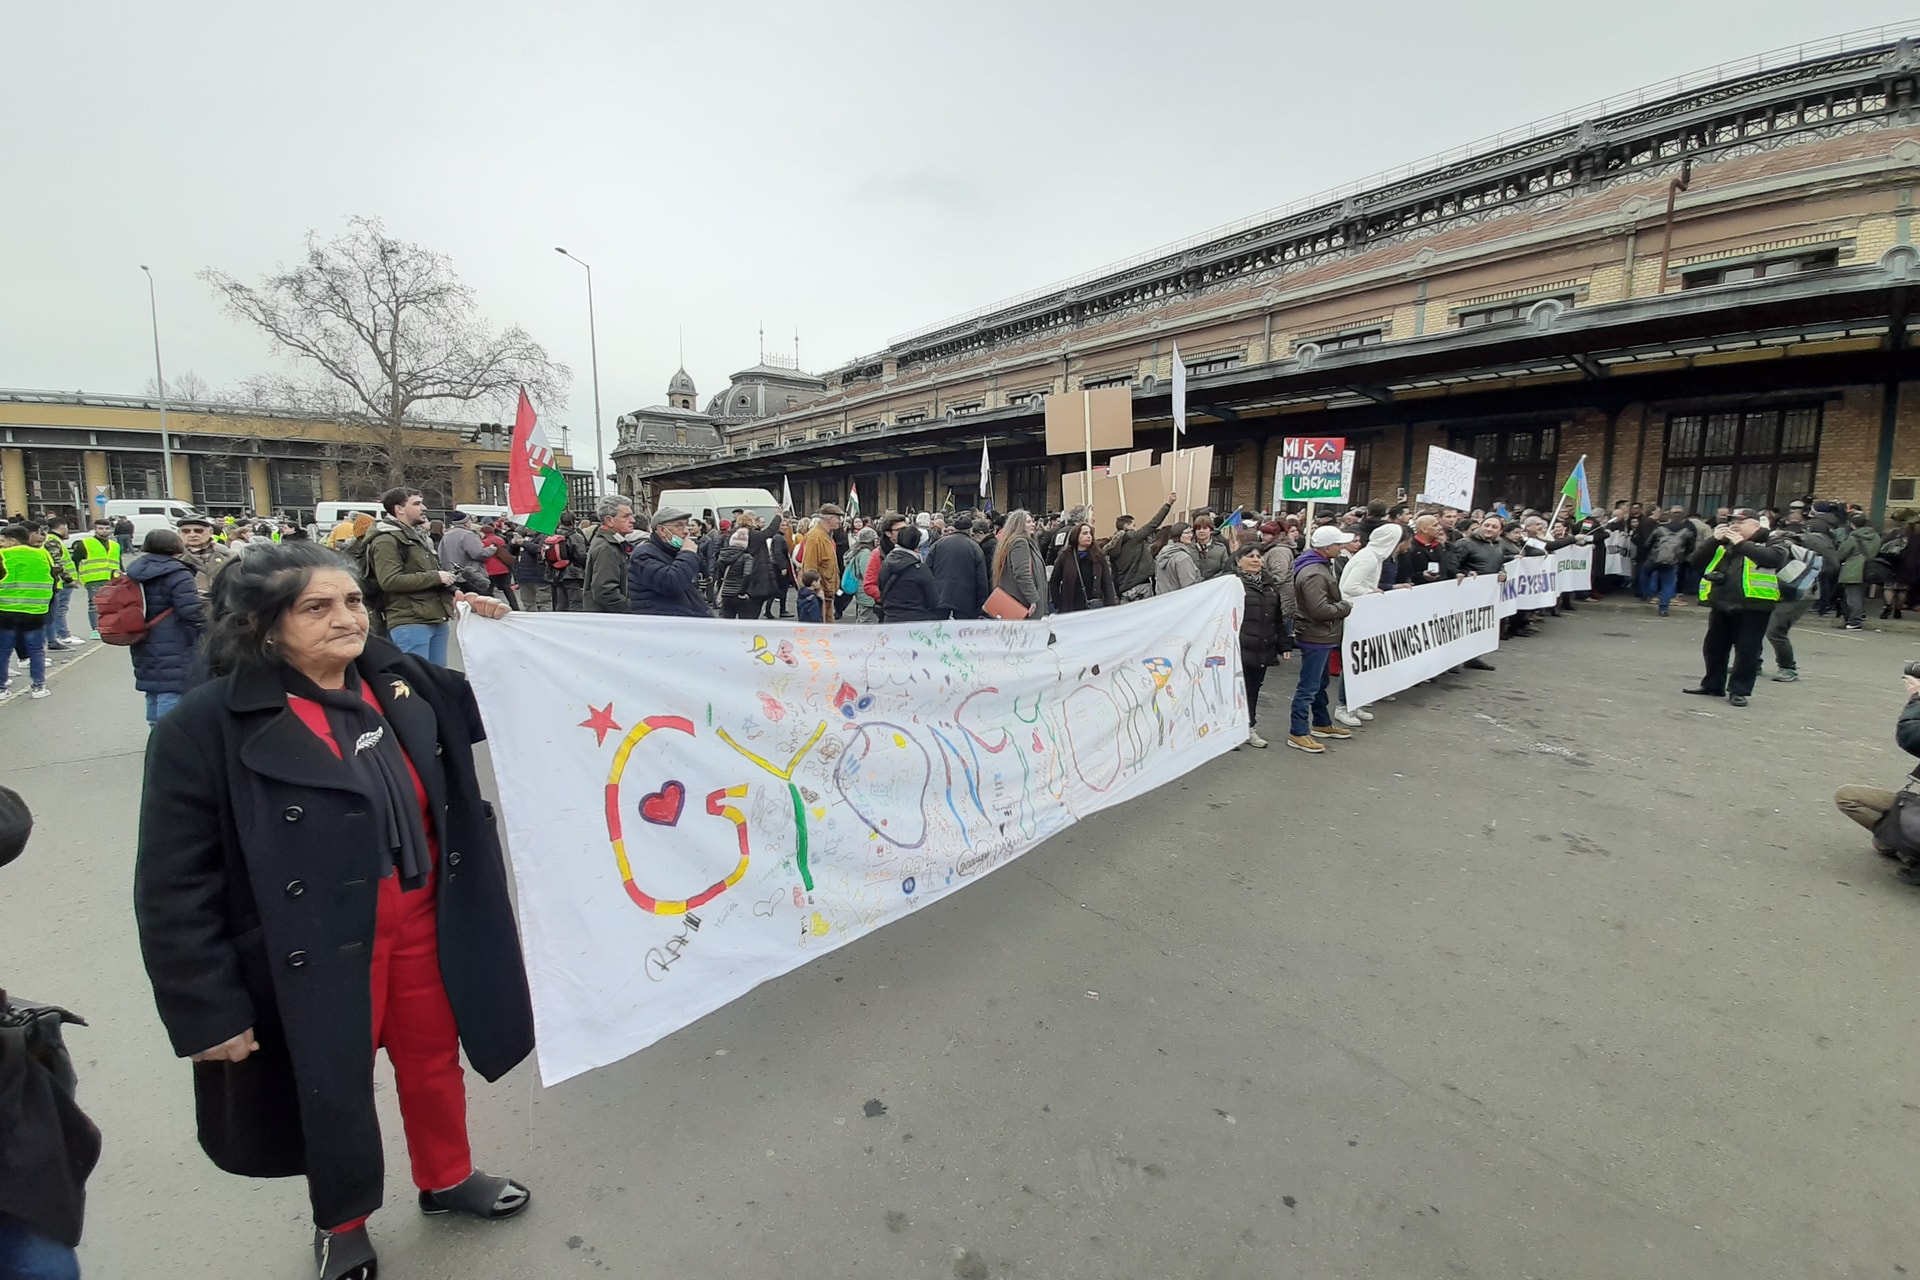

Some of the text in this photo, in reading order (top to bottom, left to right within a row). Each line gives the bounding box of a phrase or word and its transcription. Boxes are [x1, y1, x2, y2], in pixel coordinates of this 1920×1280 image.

[1284, 459, 1341, 475] MAGYAROK
[1350, 605, 1495, 675] SENKI NINCS A TÖRVÉNY FELETT!
